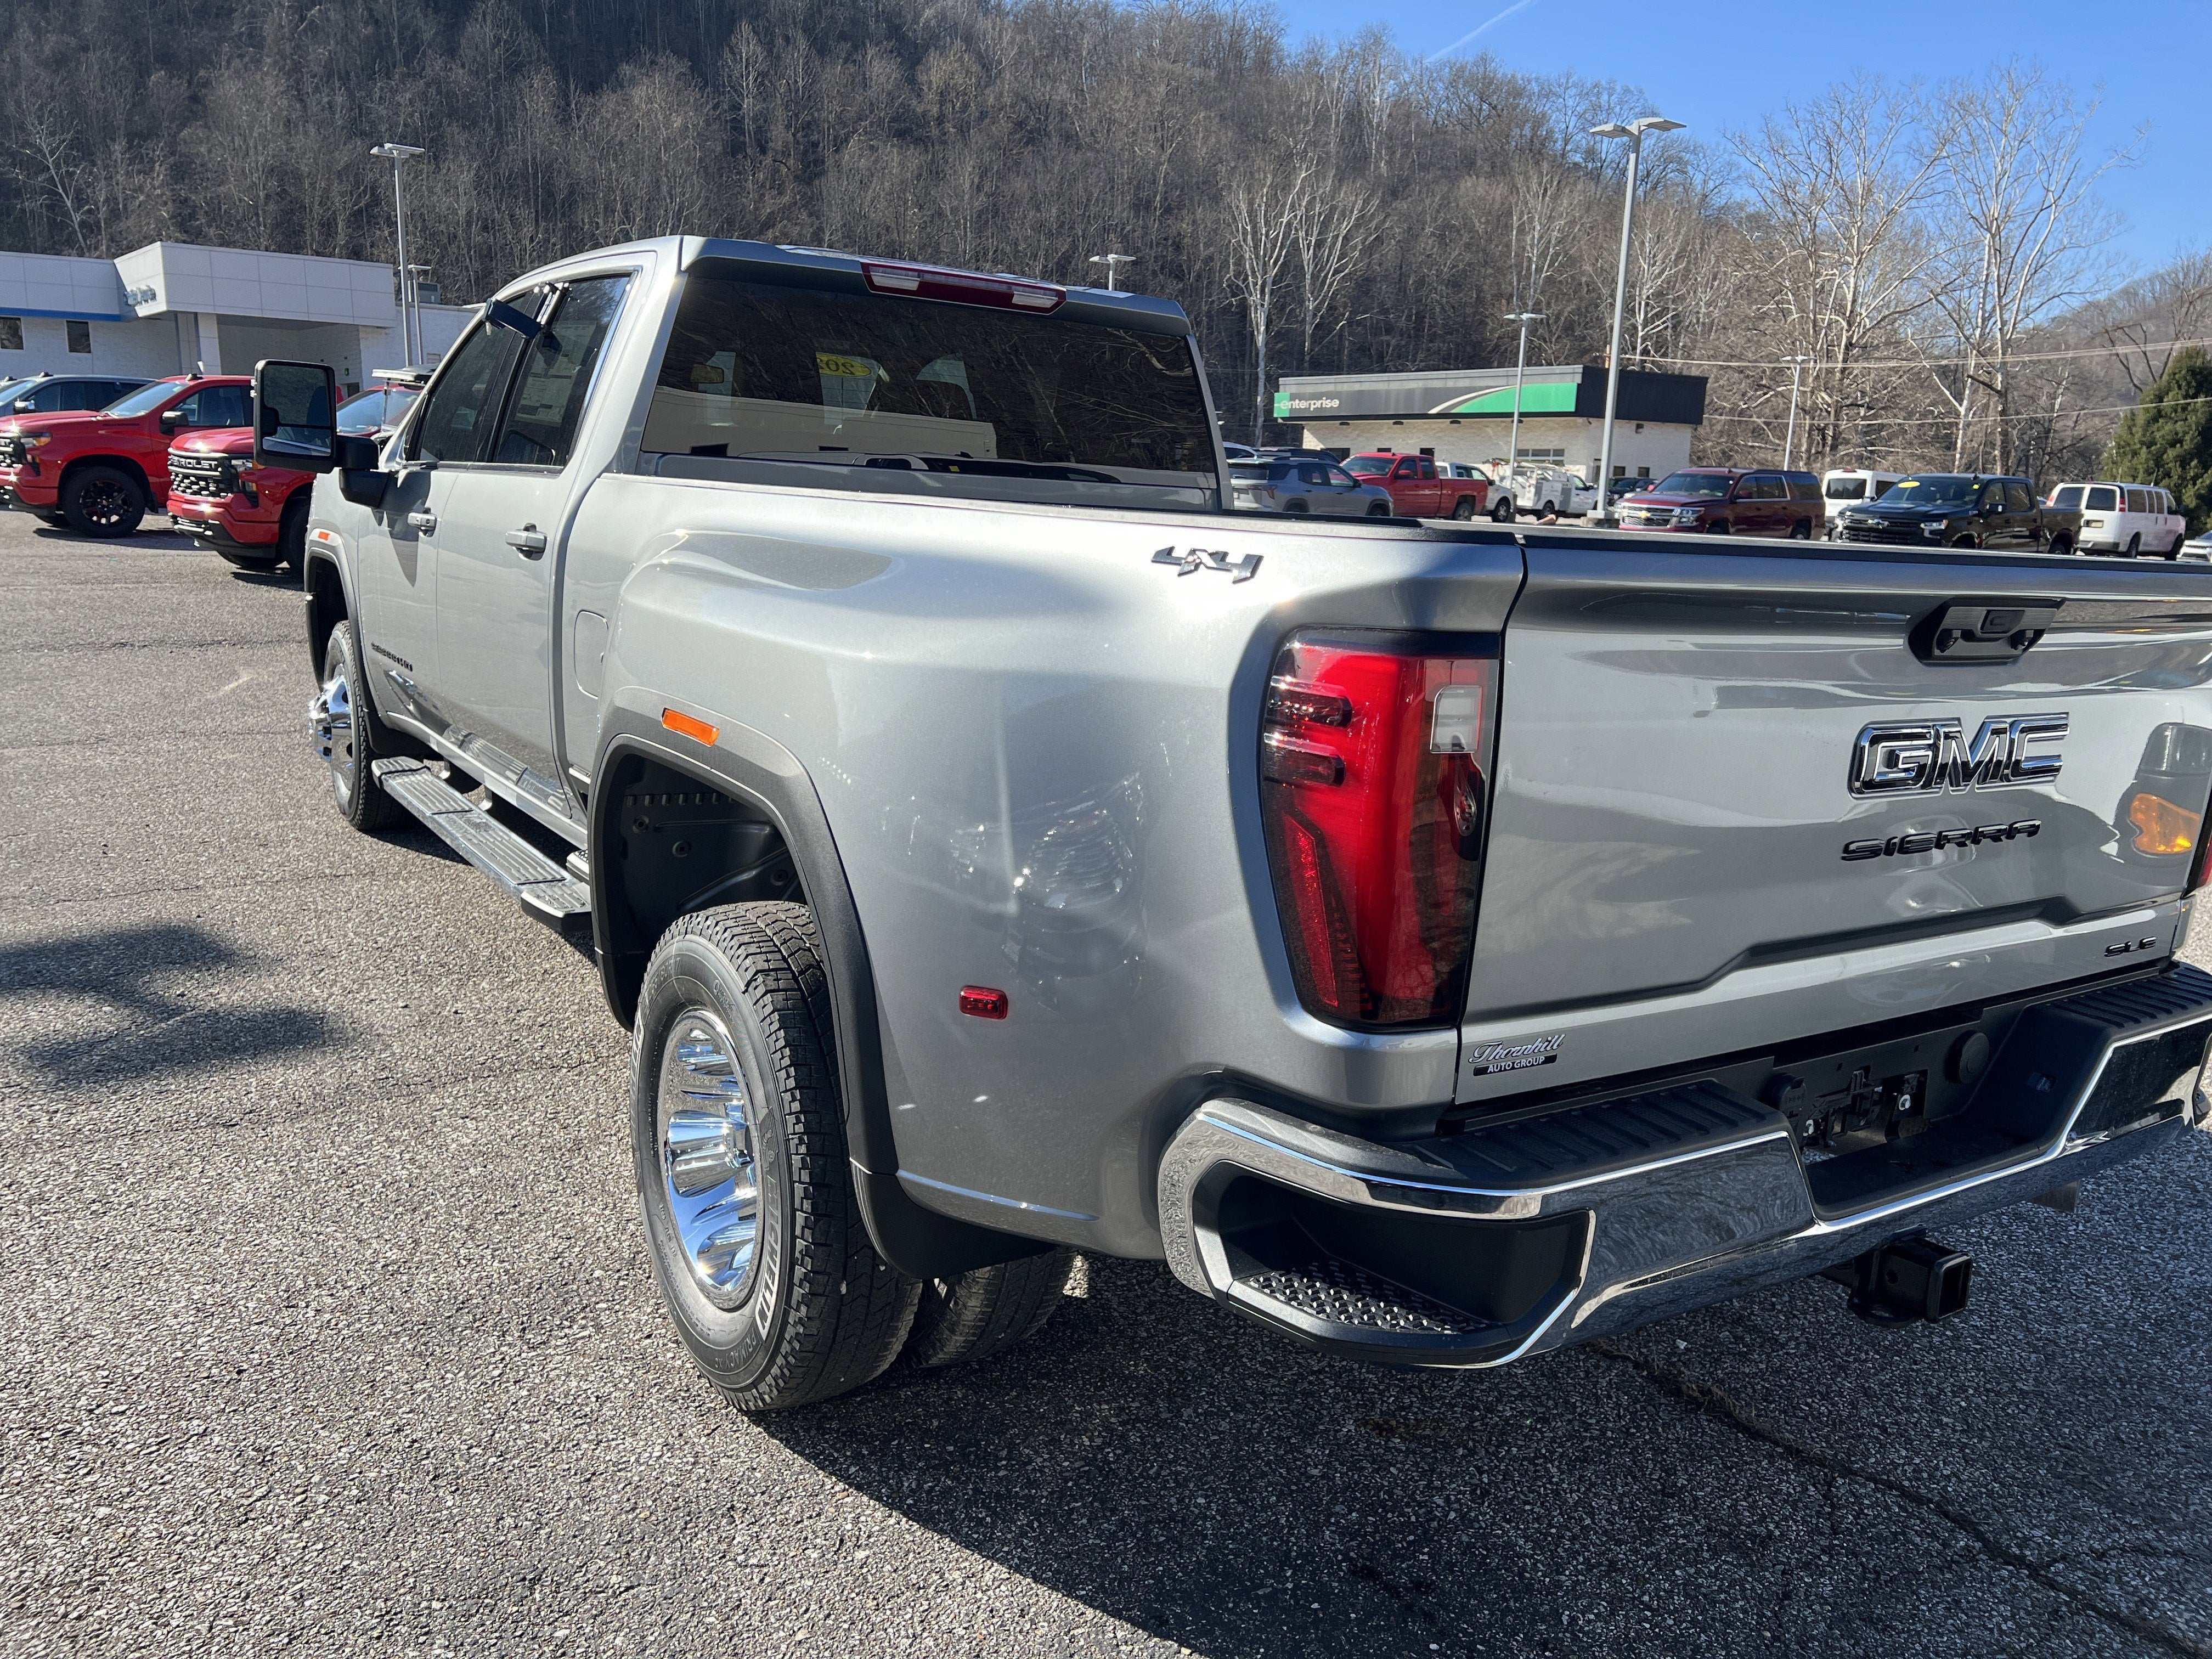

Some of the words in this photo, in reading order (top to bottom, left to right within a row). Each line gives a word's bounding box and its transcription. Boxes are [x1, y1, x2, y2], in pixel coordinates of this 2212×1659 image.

[1280, 397, 1340, 411] enterprise
[1848, 712, 2069, 801] GMC
[1841, 819, 2042, 861] SIERRA
[2104, 935, 2157, 957] SLE
[1468, 1034, 1566, 1064] Thornhill
[1487, 1062, 1513, 1073] AUTO
[1514, 1056, 1545, 1069] GROUP
[756, 1174, 779, 1331] MICHELIN
[725, 1327, 757, 1369] PRIMACY
